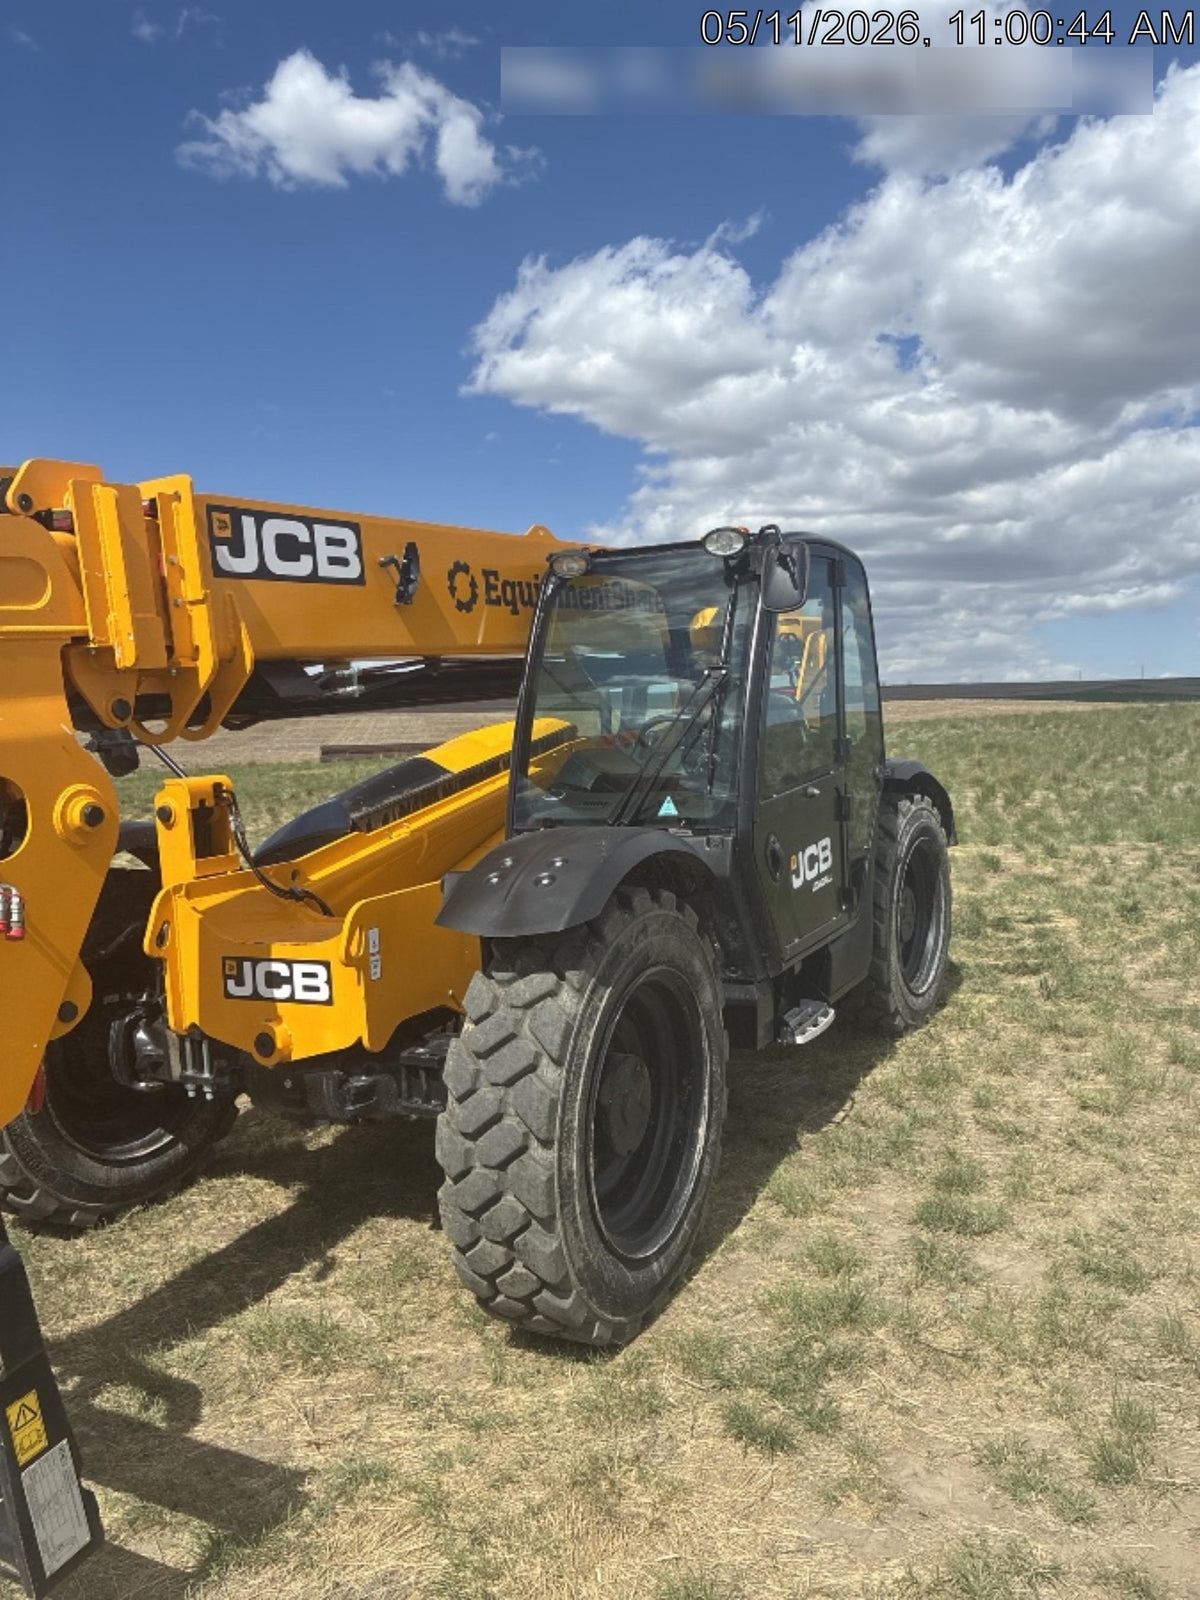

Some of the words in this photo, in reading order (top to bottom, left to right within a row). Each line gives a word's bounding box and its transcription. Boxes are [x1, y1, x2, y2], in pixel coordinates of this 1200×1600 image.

[215, 515, 362, 579] JCB
[792, 837, 833, 889] JCB
[226, 960, 330, 1002] JCB
